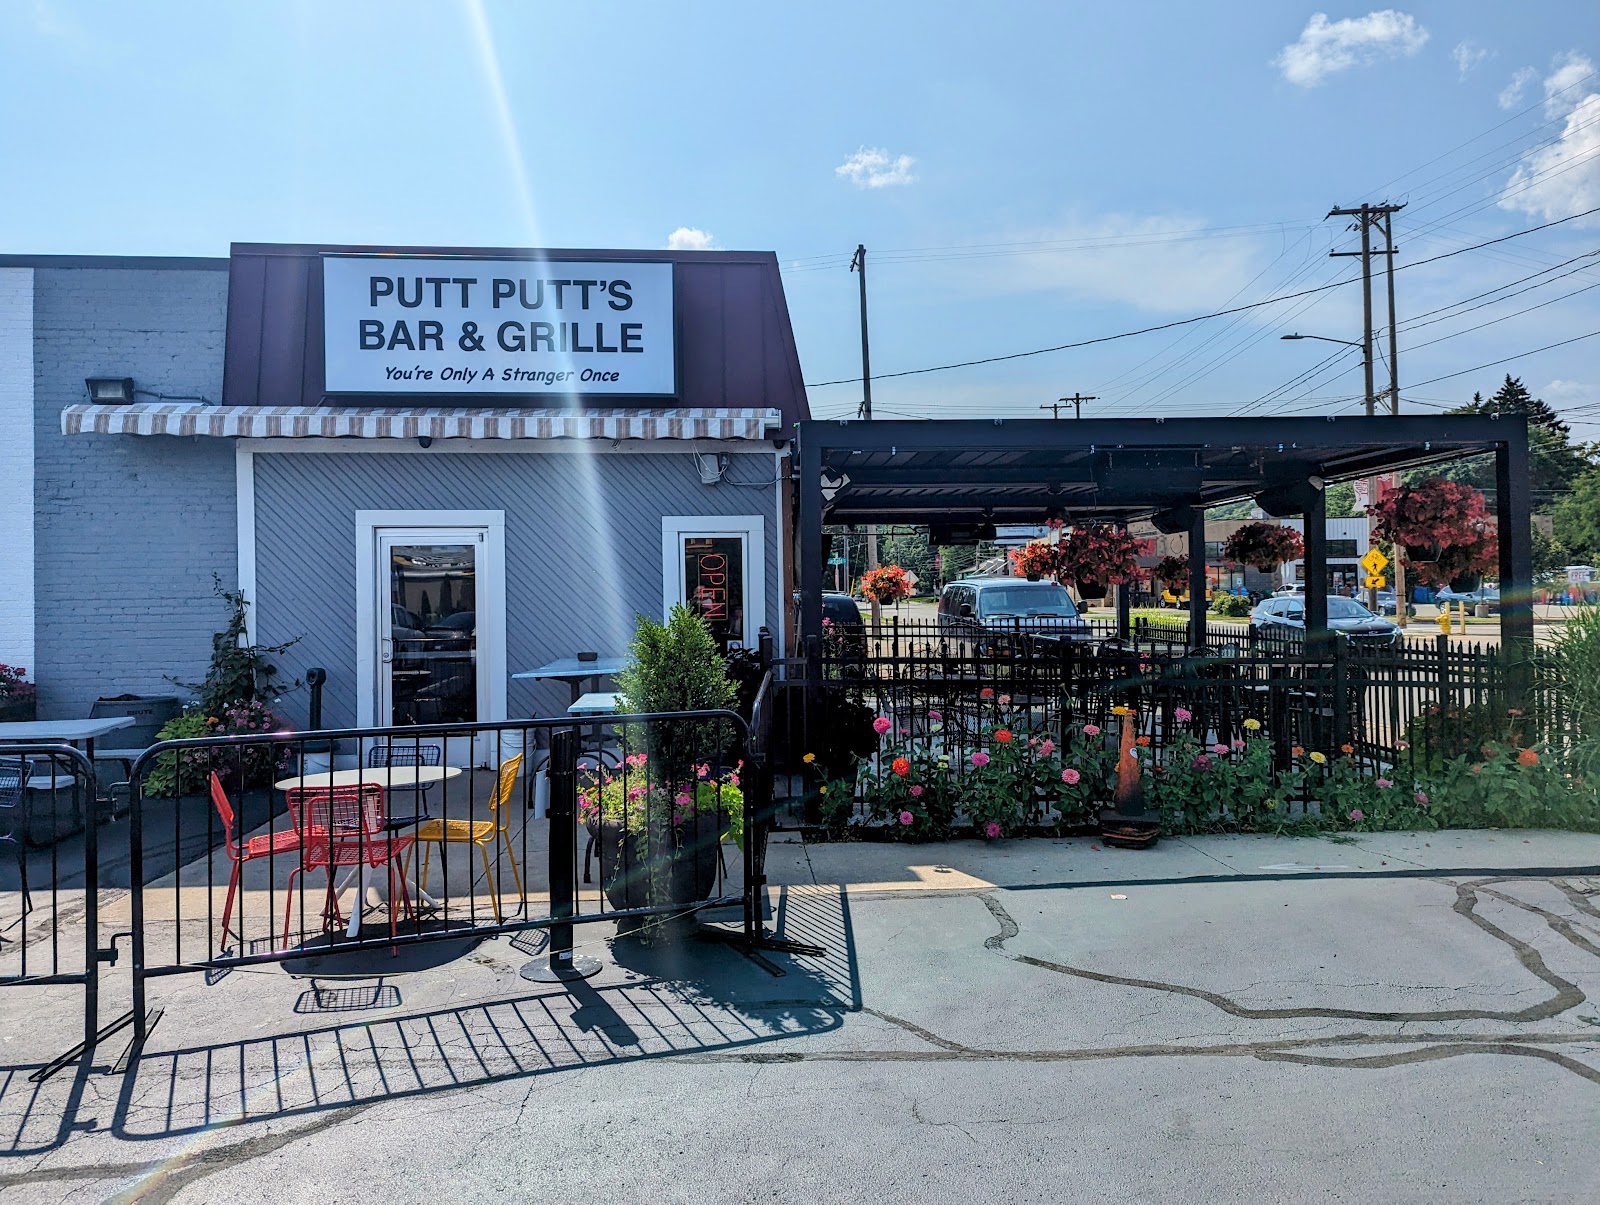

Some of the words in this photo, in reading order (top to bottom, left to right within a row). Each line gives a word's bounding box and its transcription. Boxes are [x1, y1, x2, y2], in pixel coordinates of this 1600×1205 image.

[369, 276, 477, 309] PUTT
[492, 278, 633, 312] PUTT'S
[359, 319, 444, 352] BAR
[458, 320, 486, 353] &
[497, 321, 644, 354] GRILLE
[385, 365, 433, 381] You're
[440, 366, 478, 385] Only
[482, 368, 495, 382] A
[501, 367, 574, 386] Stranger
[580, 368, 620, 382] Once
[700, 554, 726, 618] OPEN
